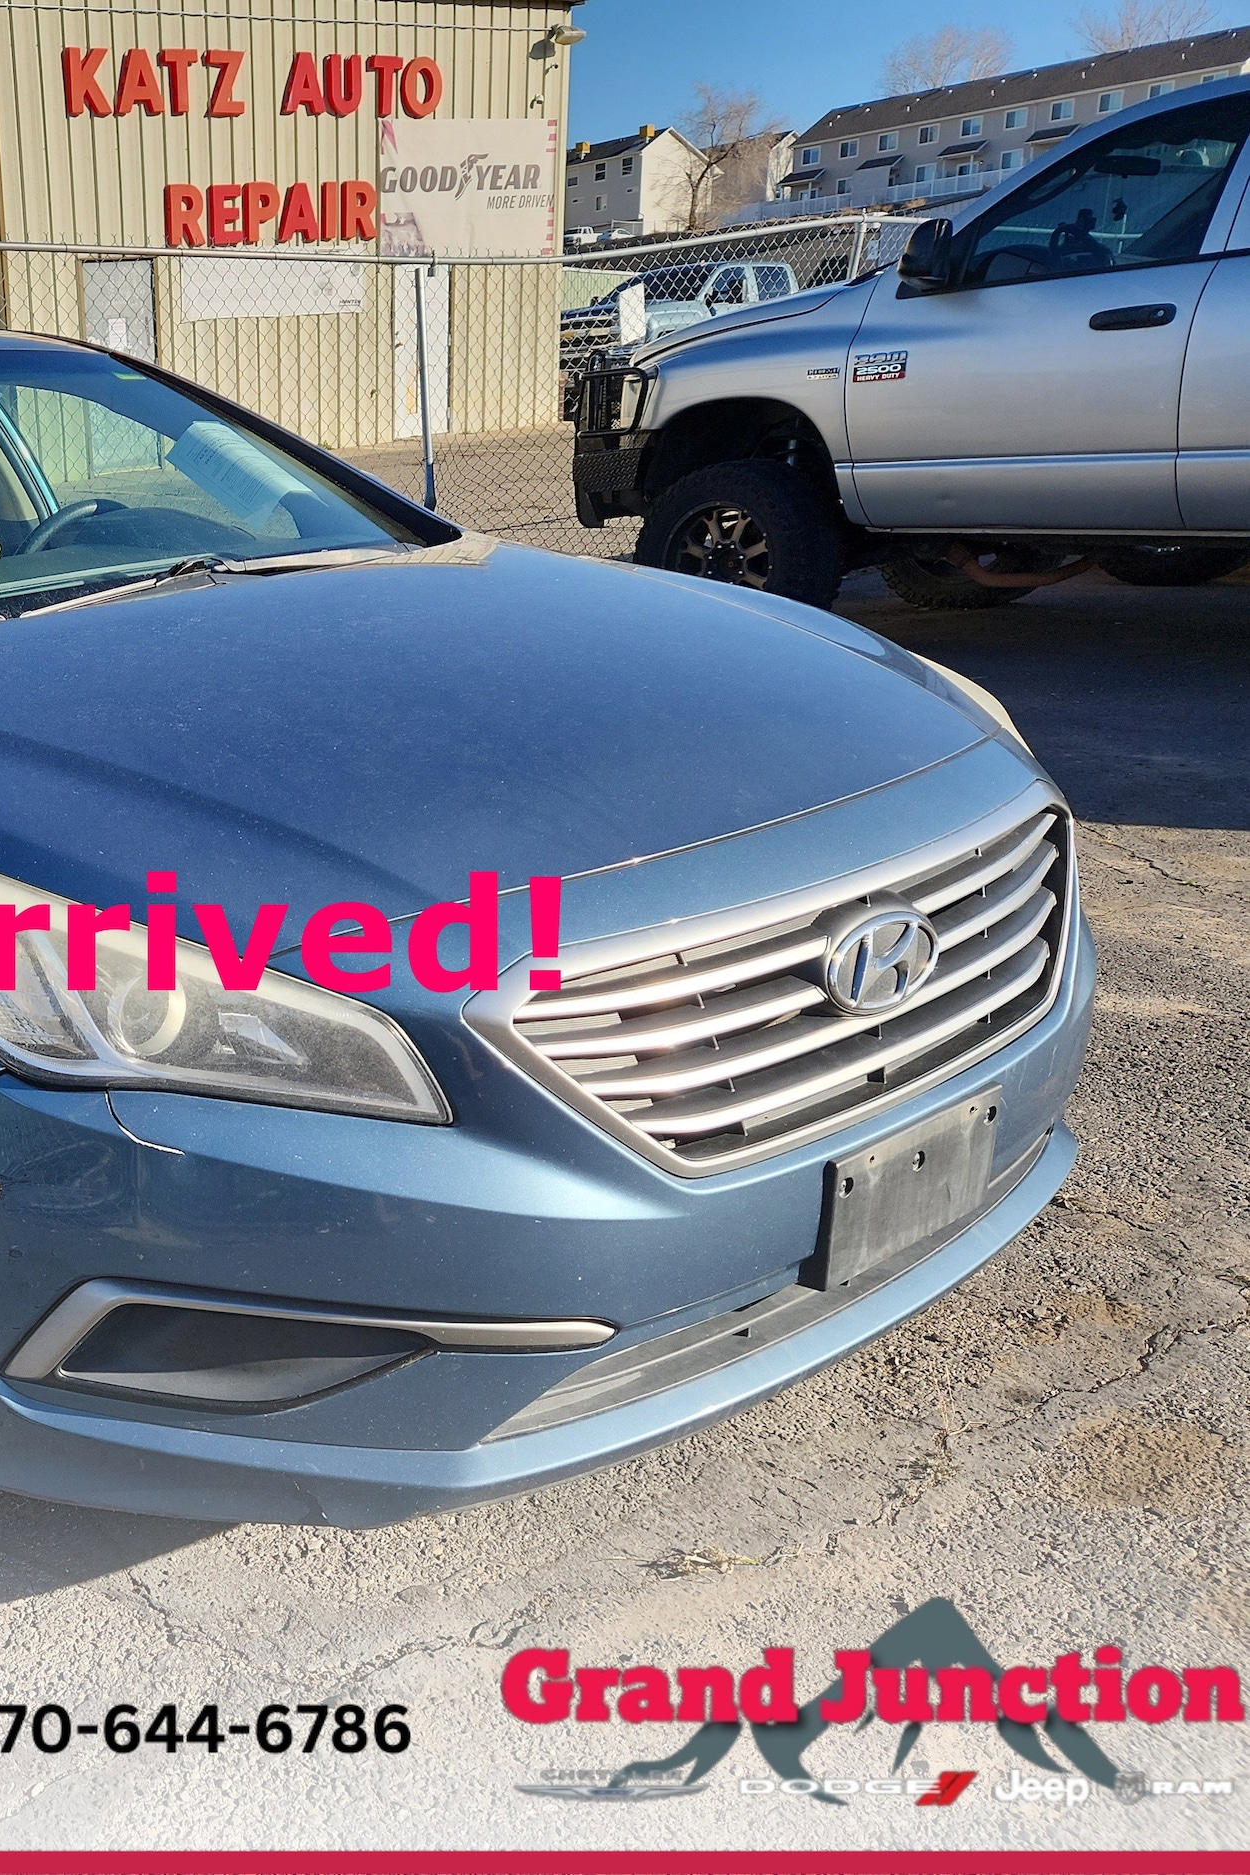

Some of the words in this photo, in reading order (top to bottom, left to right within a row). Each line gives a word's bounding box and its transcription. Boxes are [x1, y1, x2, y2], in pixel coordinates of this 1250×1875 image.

[62, 47, 245, 117] KATZ
[280, 52, 443, 118] AUTO
[486, 195, 517, 210] MORE
[518, 193, 555, 209] DRIVEN
[165, 180, 377, 247] REPAIR
[854, 351, 908, 365] RAM
[856, 363, 901, 376] 2500
[856, 374, 880, 382] HEAVY
[881, 372, 901, 380] DUTY
